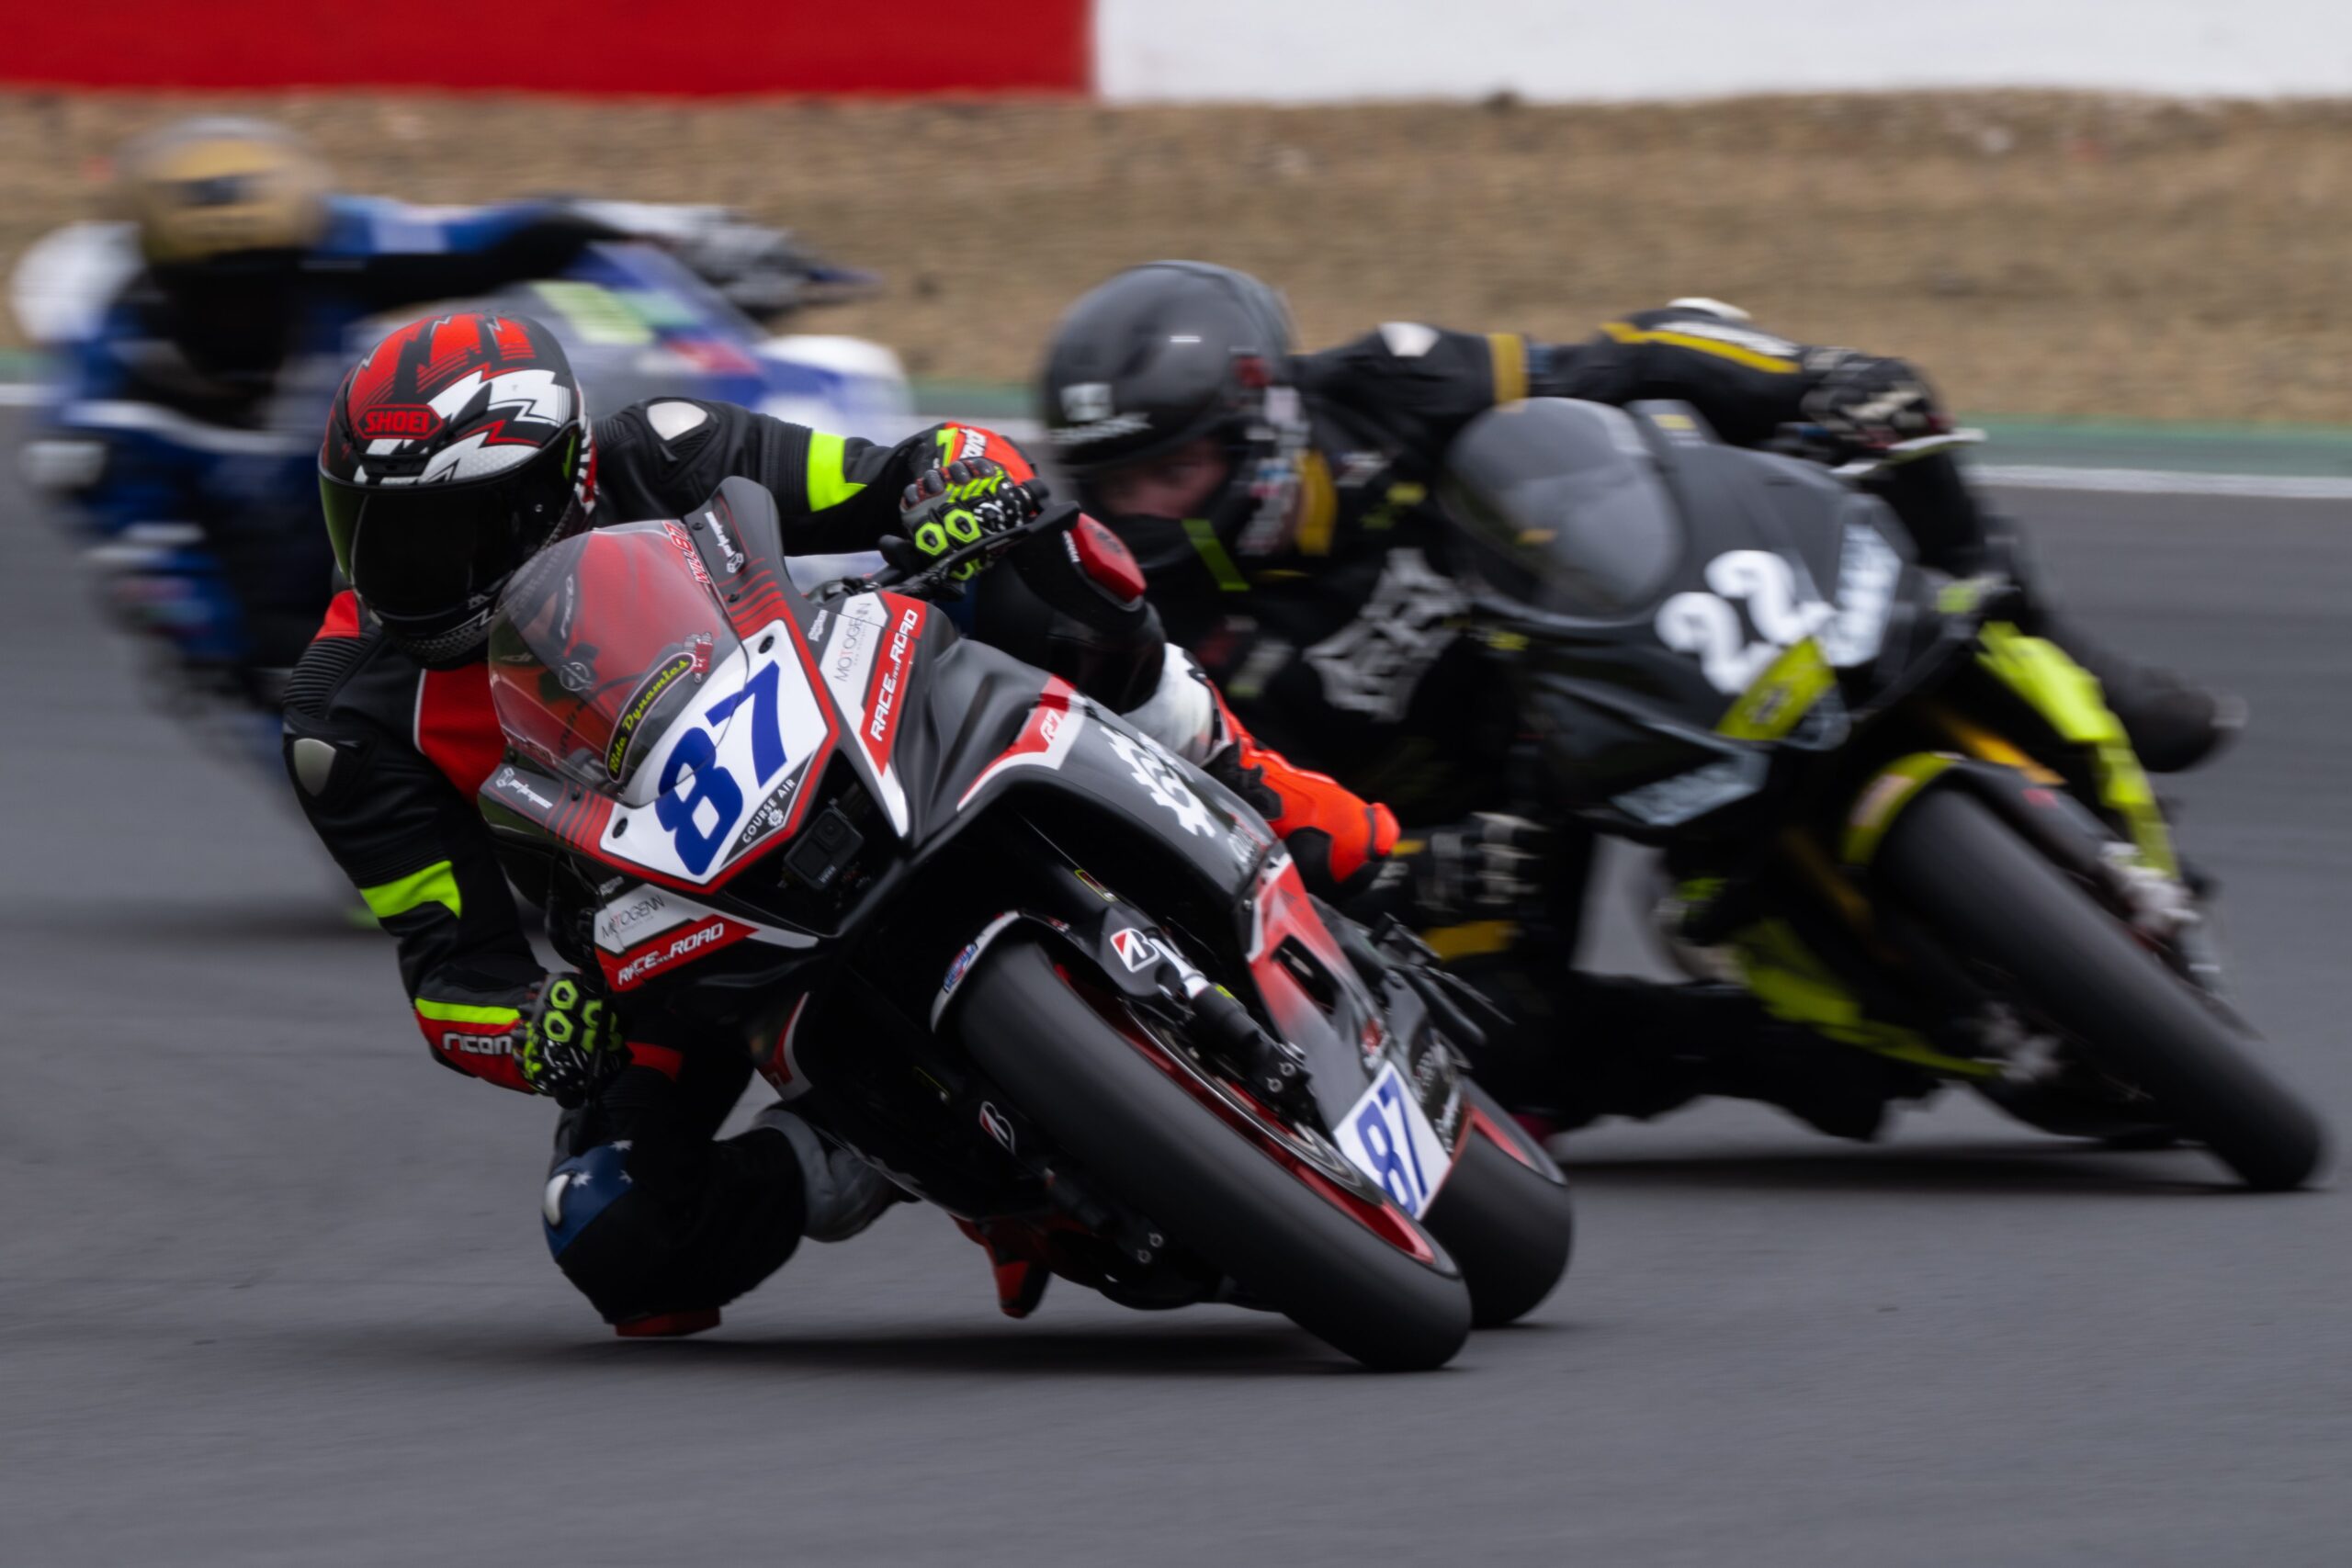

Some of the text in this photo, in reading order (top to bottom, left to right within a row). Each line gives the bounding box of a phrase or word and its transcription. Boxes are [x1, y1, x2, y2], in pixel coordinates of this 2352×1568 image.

[364, 412, 430, 433] SHOEI
[1656, 549, 1837, 694] 22
[622, 660, 689, 731] Dynamics
[870, 608, 918, 741] RACE ROAD
[654, 659, 787, 876] 87
[741, 777, 797, 844] COURSE AIR
[670, 922, 724, 958] ROAD
[1355, 1071, 1429, 1219] 87
